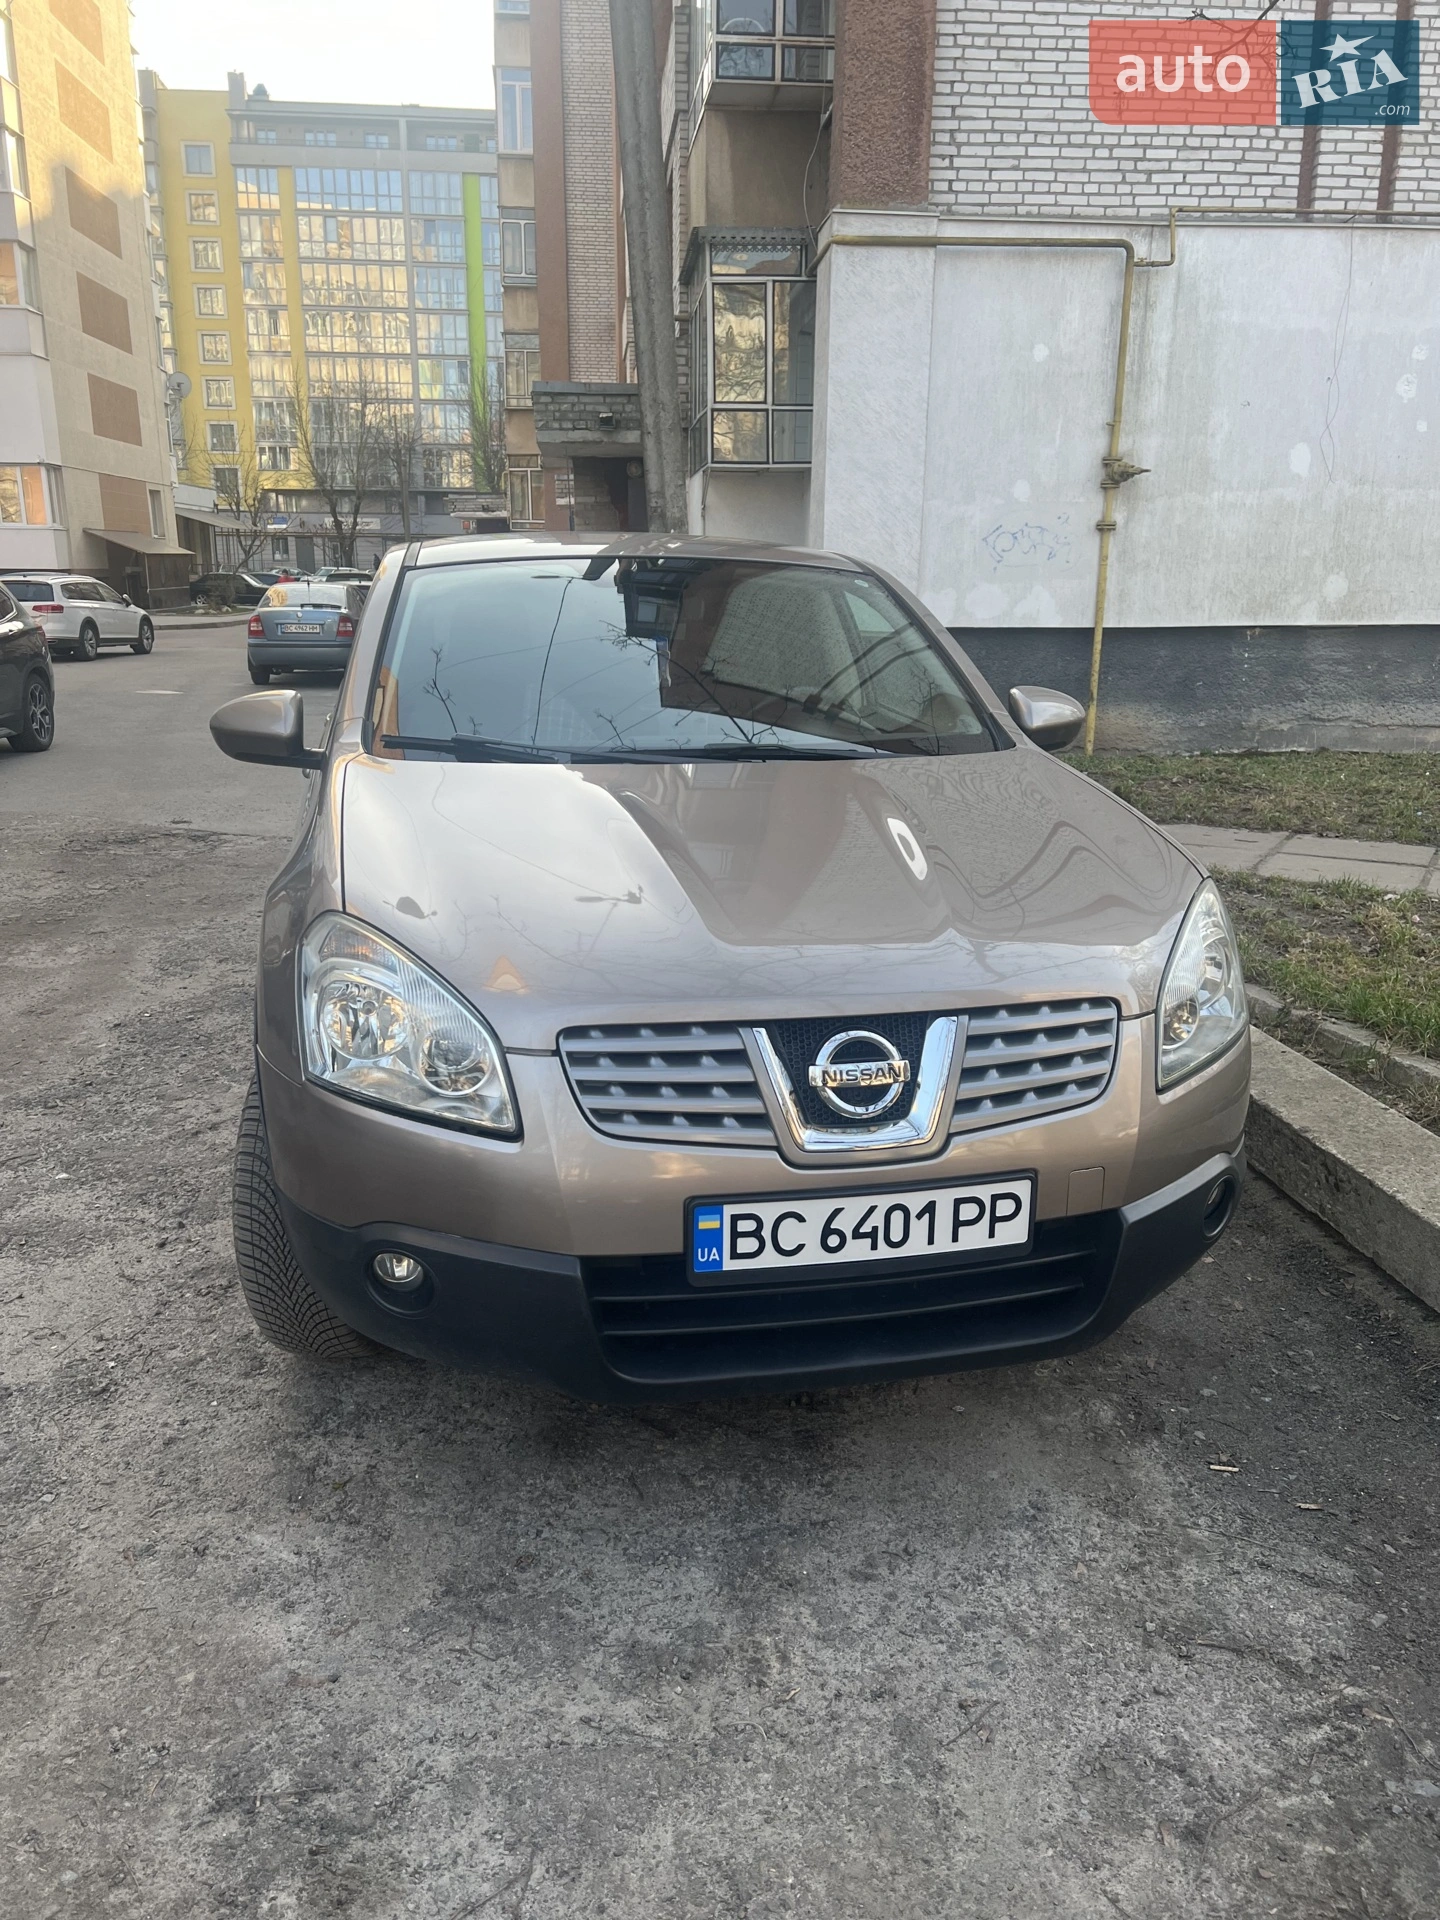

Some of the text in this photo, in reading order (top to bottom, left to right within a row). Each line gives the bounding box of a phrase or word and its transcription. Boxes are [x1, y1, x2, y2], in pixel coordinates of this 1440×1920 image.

[821, 1063, 902, 1084] NISSAN
[729, 1191, 1023, 1260] BC 6401 PP
[697, 1247, 720, 1262] UA
